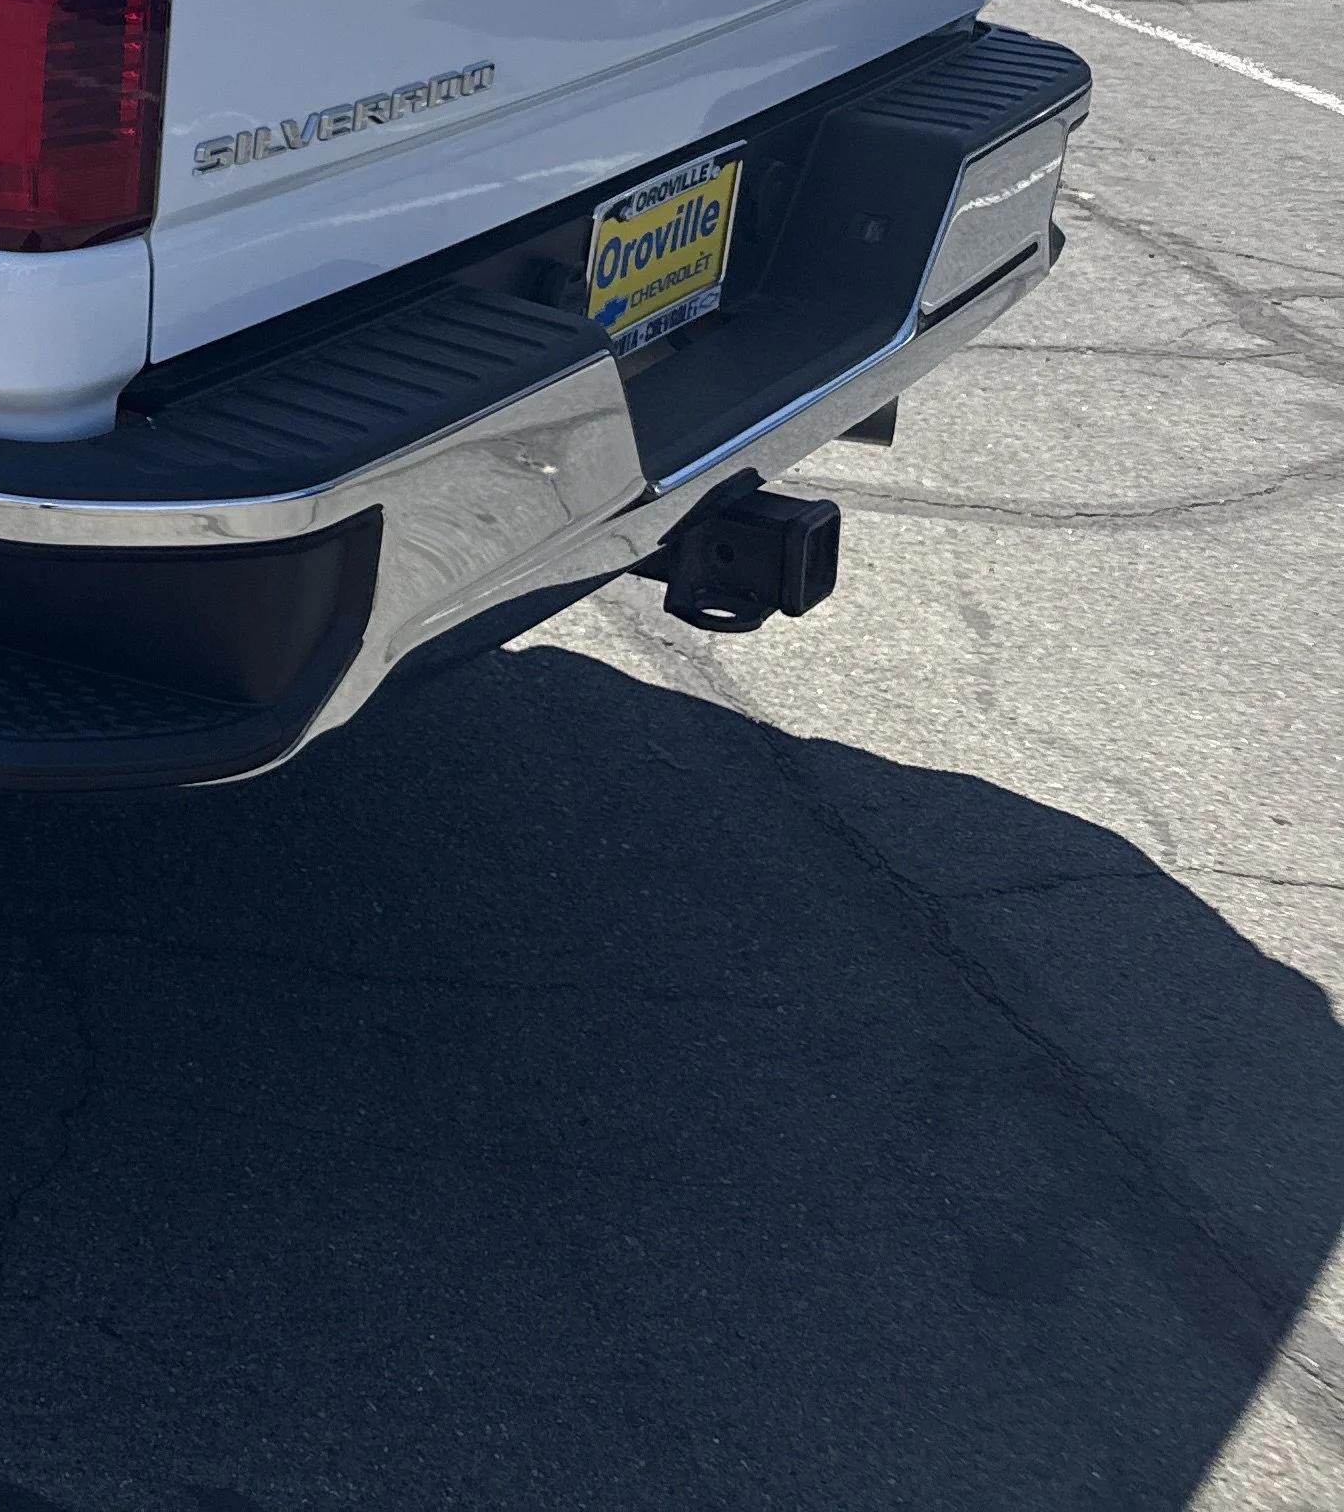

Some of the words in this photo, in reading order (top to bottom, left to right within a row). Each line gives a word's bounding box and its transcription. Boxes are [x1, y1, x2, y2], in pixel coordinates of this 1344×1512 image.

[192, 59, 496, 176] SILVERADO
[635, 162, 711, 212] OROVILLE
[596, 194, 721, 289] Oroville
[629, 252, 713, 309] CHEVROLET
